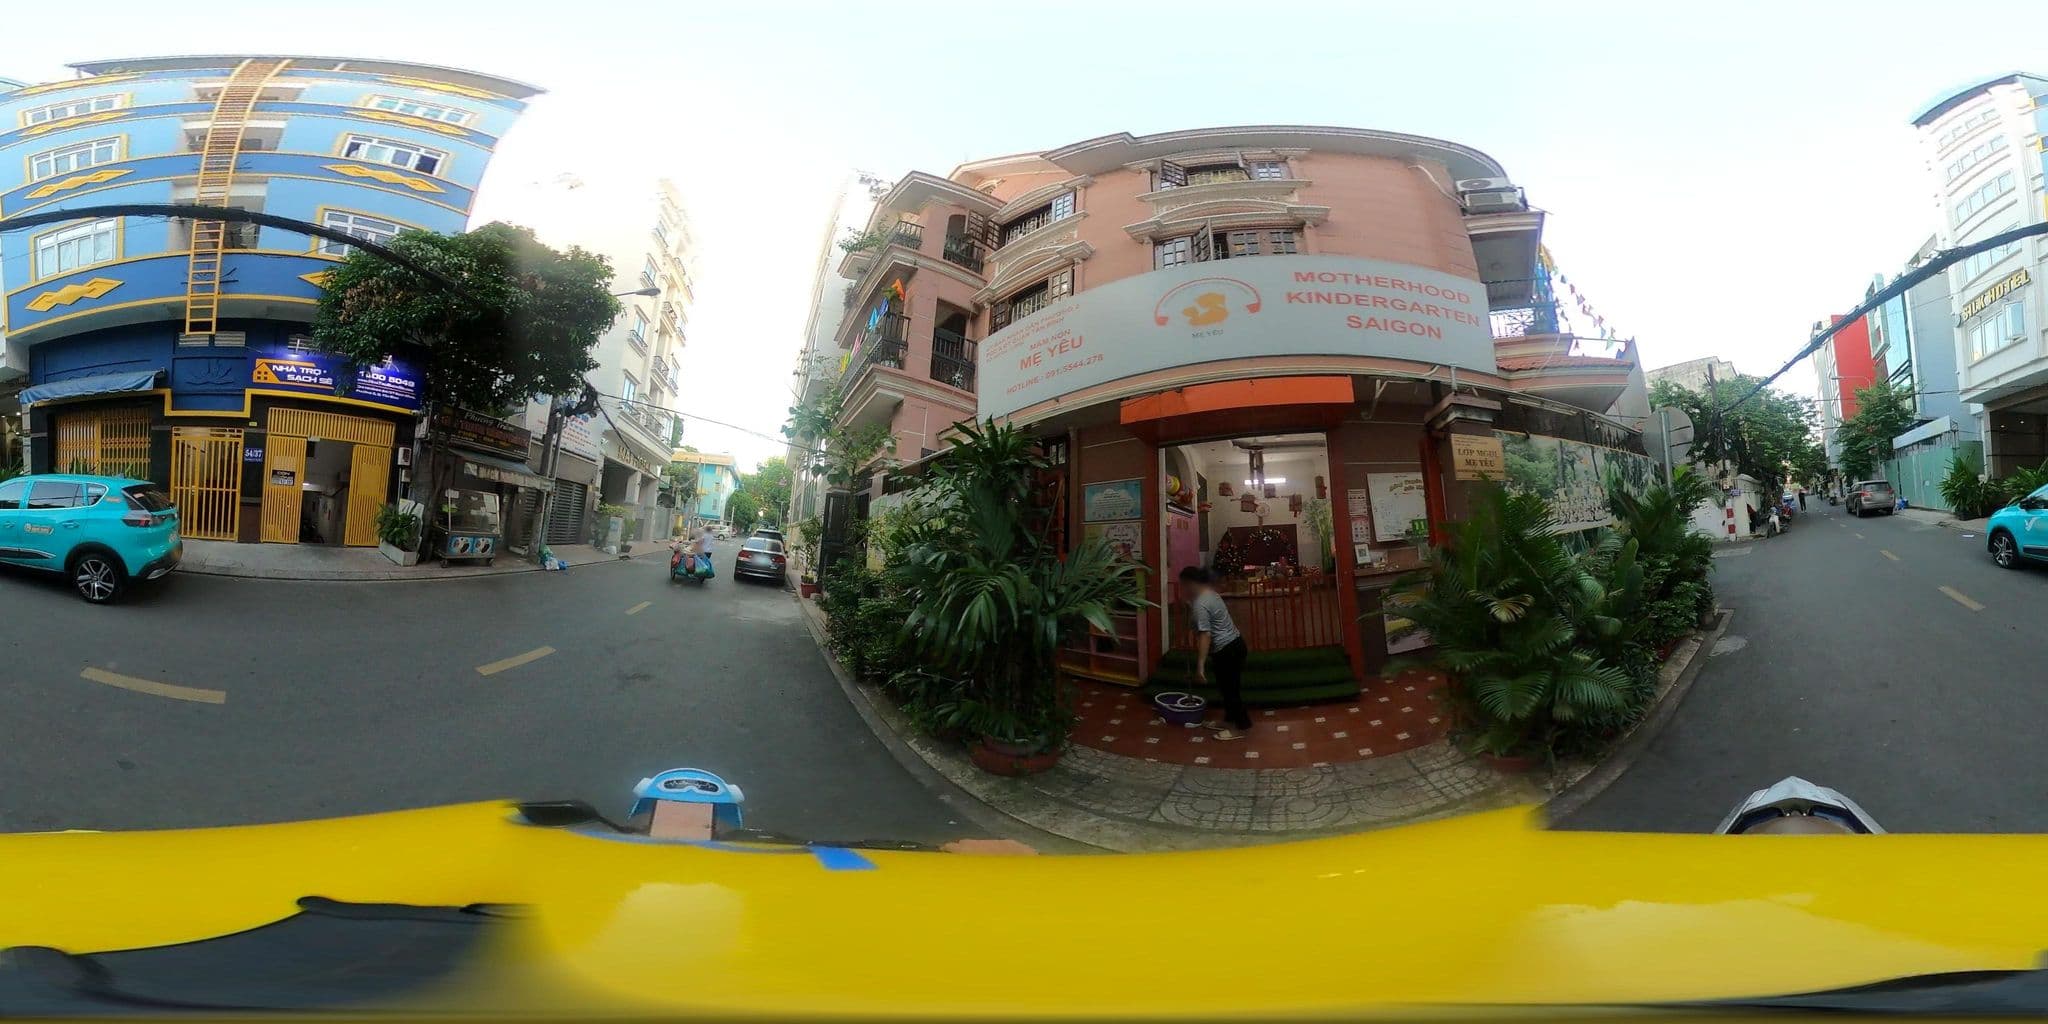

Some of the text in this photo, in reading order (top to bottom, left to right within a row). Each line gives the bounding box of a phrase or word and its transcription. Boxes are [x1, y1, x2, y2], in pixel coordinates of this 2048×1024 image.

[1294, 271, 1471, 305] MOTHERHOOD
[1961, 268, 2031, 321] SILK HOTEL
[1286, 291, 1480, 327] KINDERGARTEN
[1346, 315, 1442, 340] SAIGON
[1019, 351, 1042, 370] MẸ
[1047, 335, 1084, 358] YÊU
